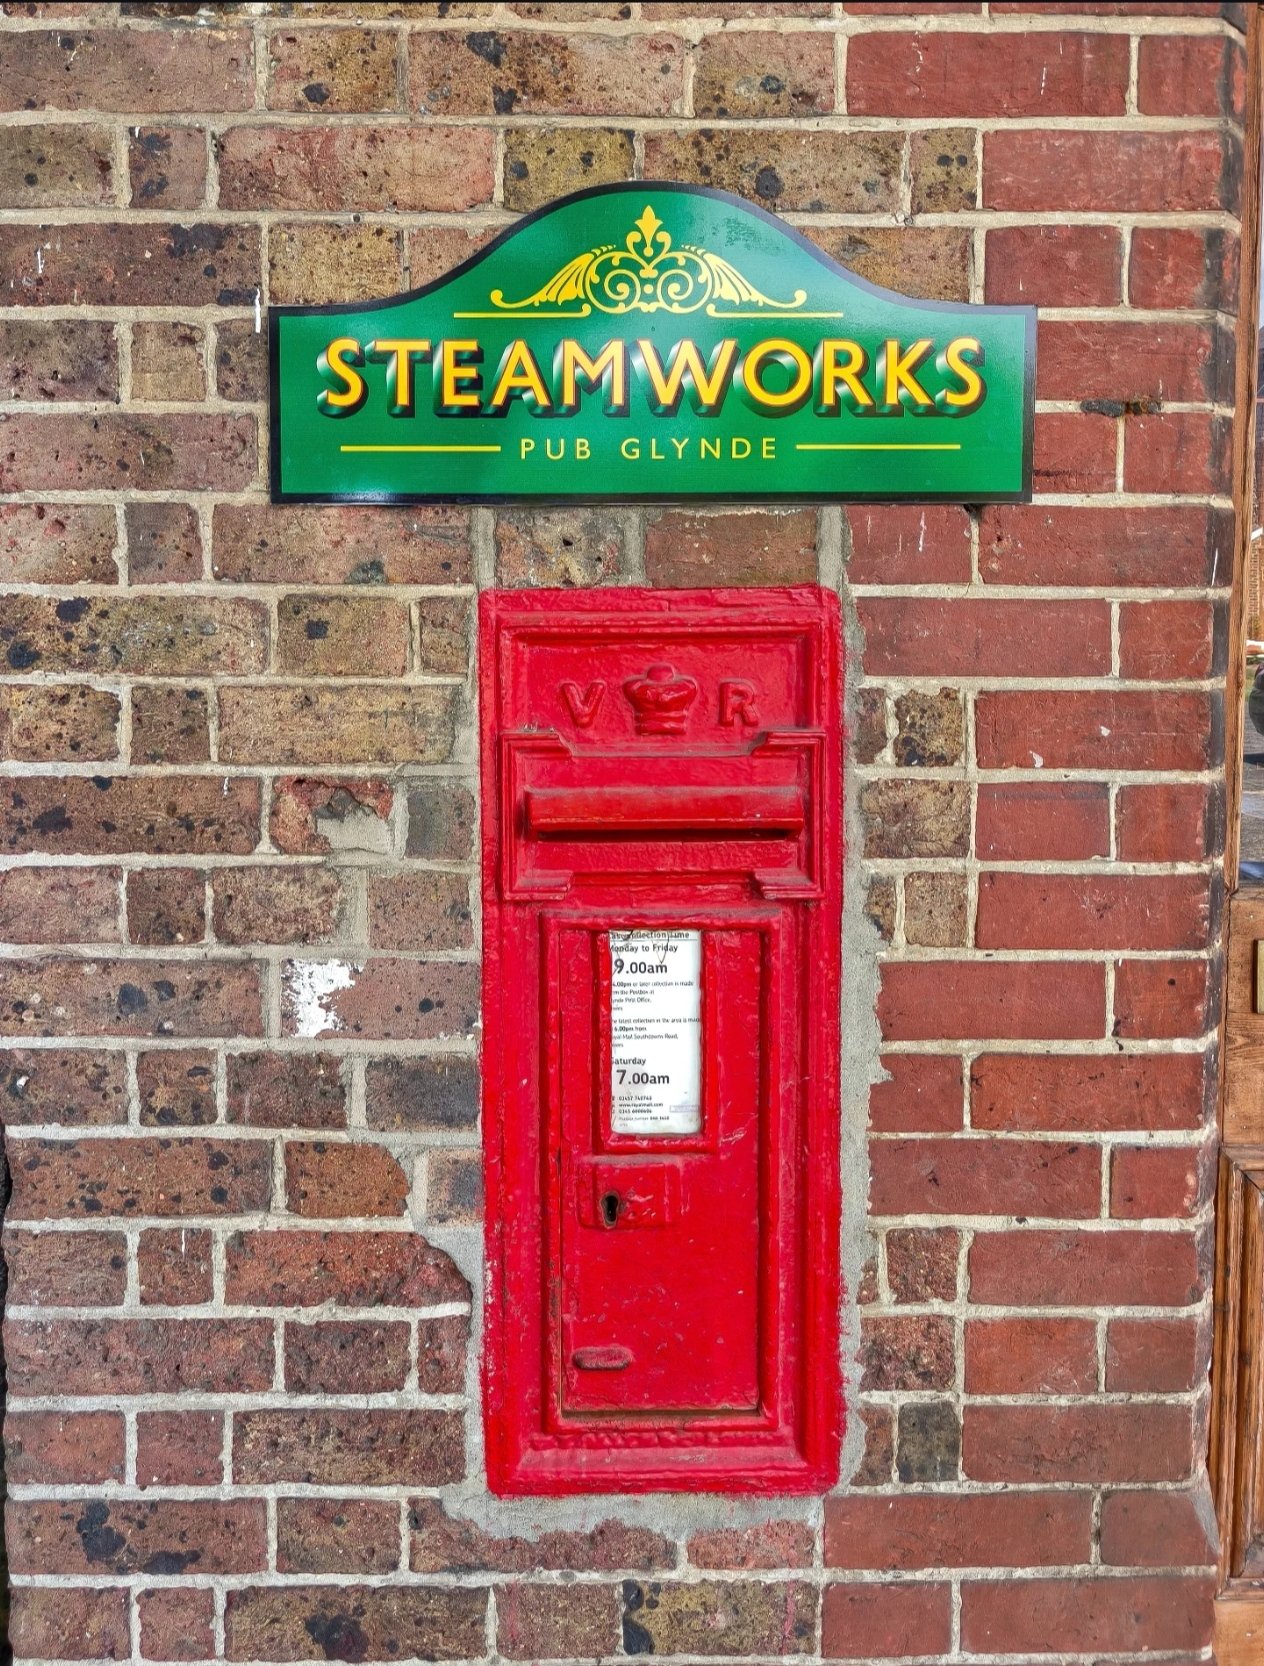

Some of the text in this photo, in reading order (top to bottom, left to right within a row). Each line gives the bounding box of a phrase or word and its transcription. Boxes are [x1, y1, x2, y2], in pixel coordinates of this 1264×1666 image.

[317, 337, 987, 418] STEAMWORKS
[520, 437, 777, 460] PUB GLYNDE
[559, 679, 760, 728] V R
[642, 944, 650, 952] to
[653, 943, 678, 953] Friday
[614, 958, 668, 974] 9.00am
[616, 1069, 670, 1085] 7.00am
